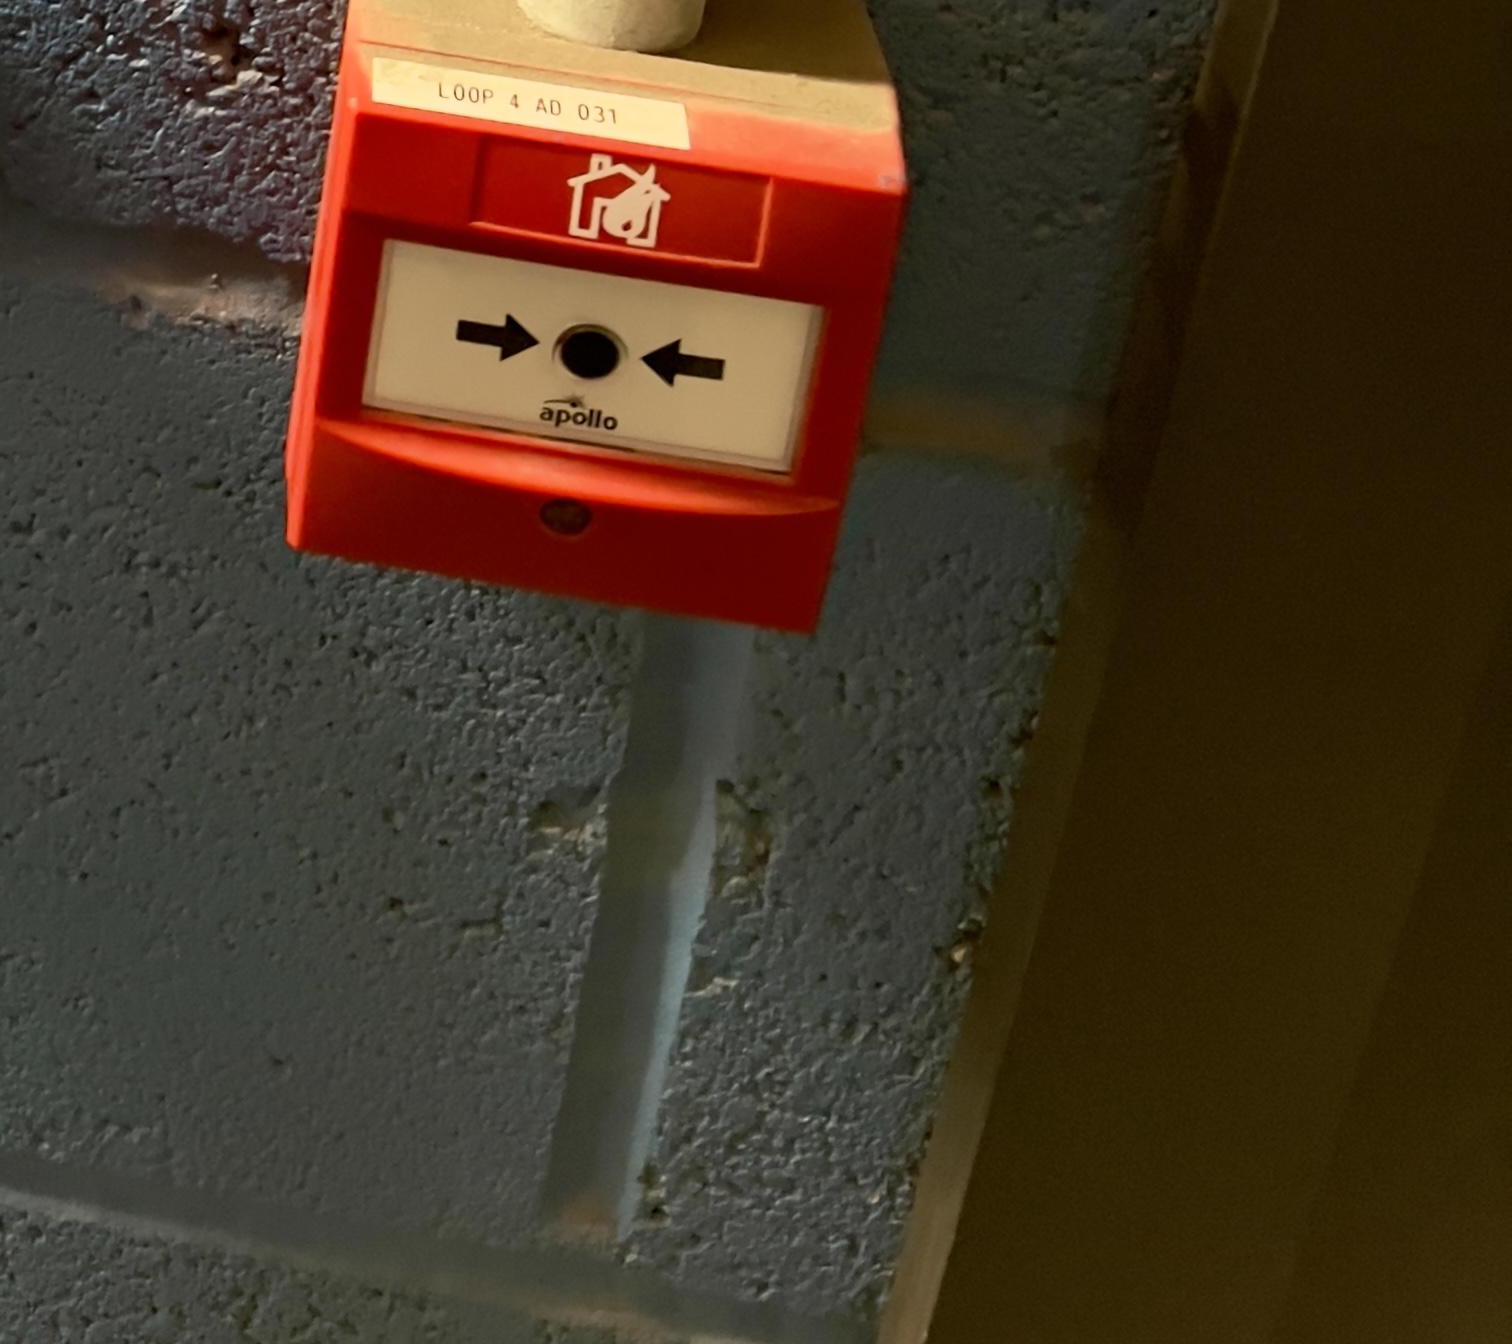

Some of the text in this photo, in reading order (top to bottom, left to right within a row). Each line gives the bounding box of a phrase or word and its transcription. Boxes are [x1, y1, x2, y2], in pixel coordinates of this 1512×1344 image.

[438, 81, 617, 124] LOOP 4 AD 031
[539, 407, 618, 431] apollo
